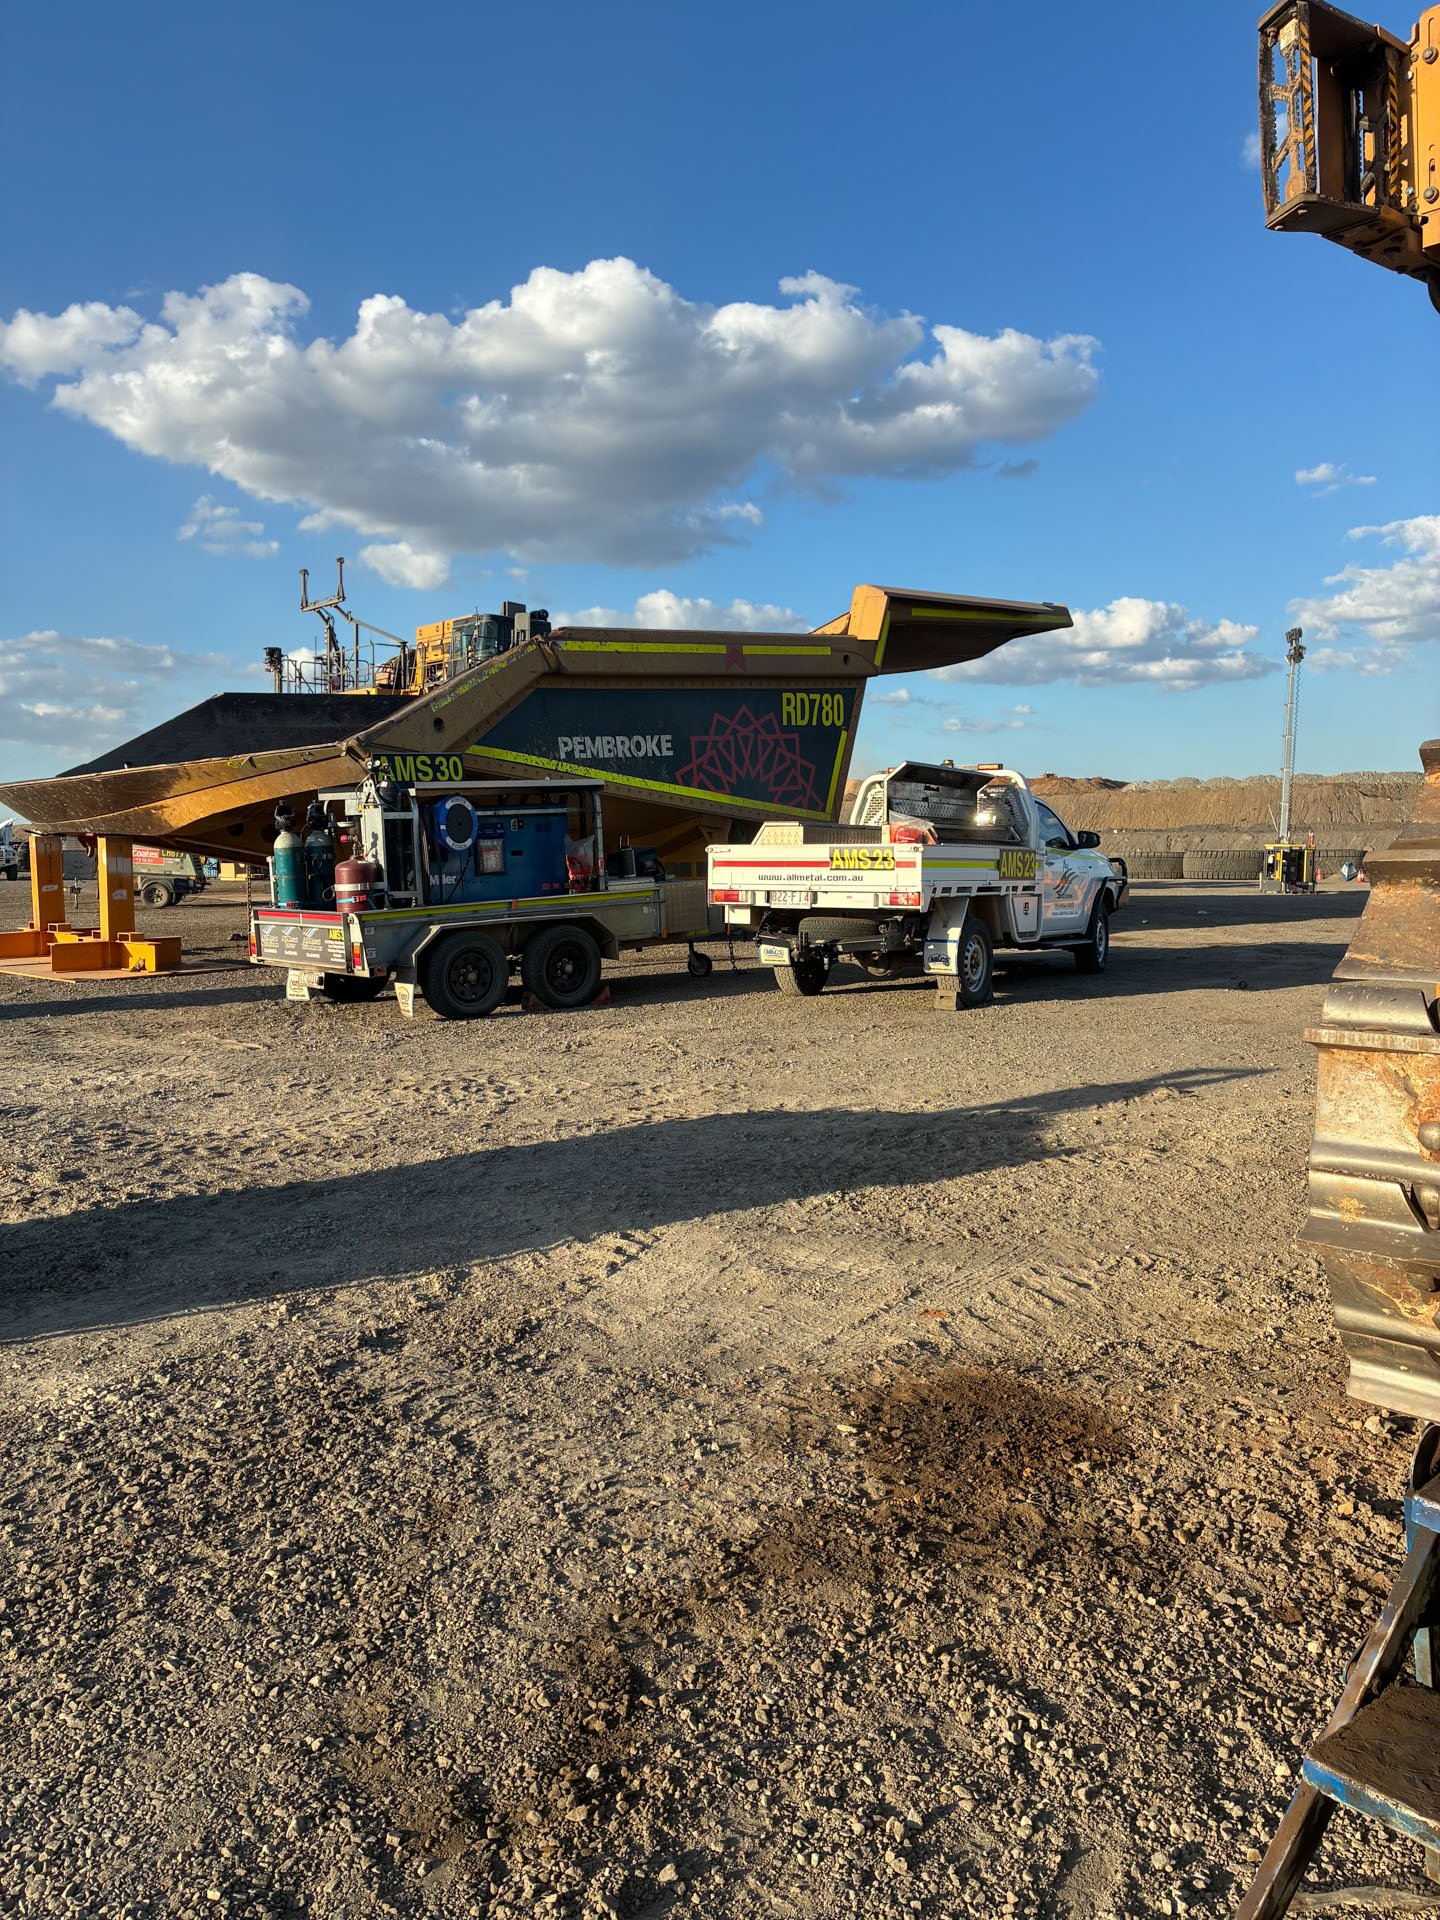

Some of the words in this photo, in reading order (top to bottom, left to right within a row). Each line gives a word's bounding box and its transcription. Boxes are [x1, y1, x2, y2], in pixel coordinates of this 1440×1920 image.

[782, 692, 844, 727] RD780
[558, 735, 674, 760] PEMBROKE
[429, 873, 457, 886] Mller
[758, 873, 864, 882] www.allmetal.com.au
